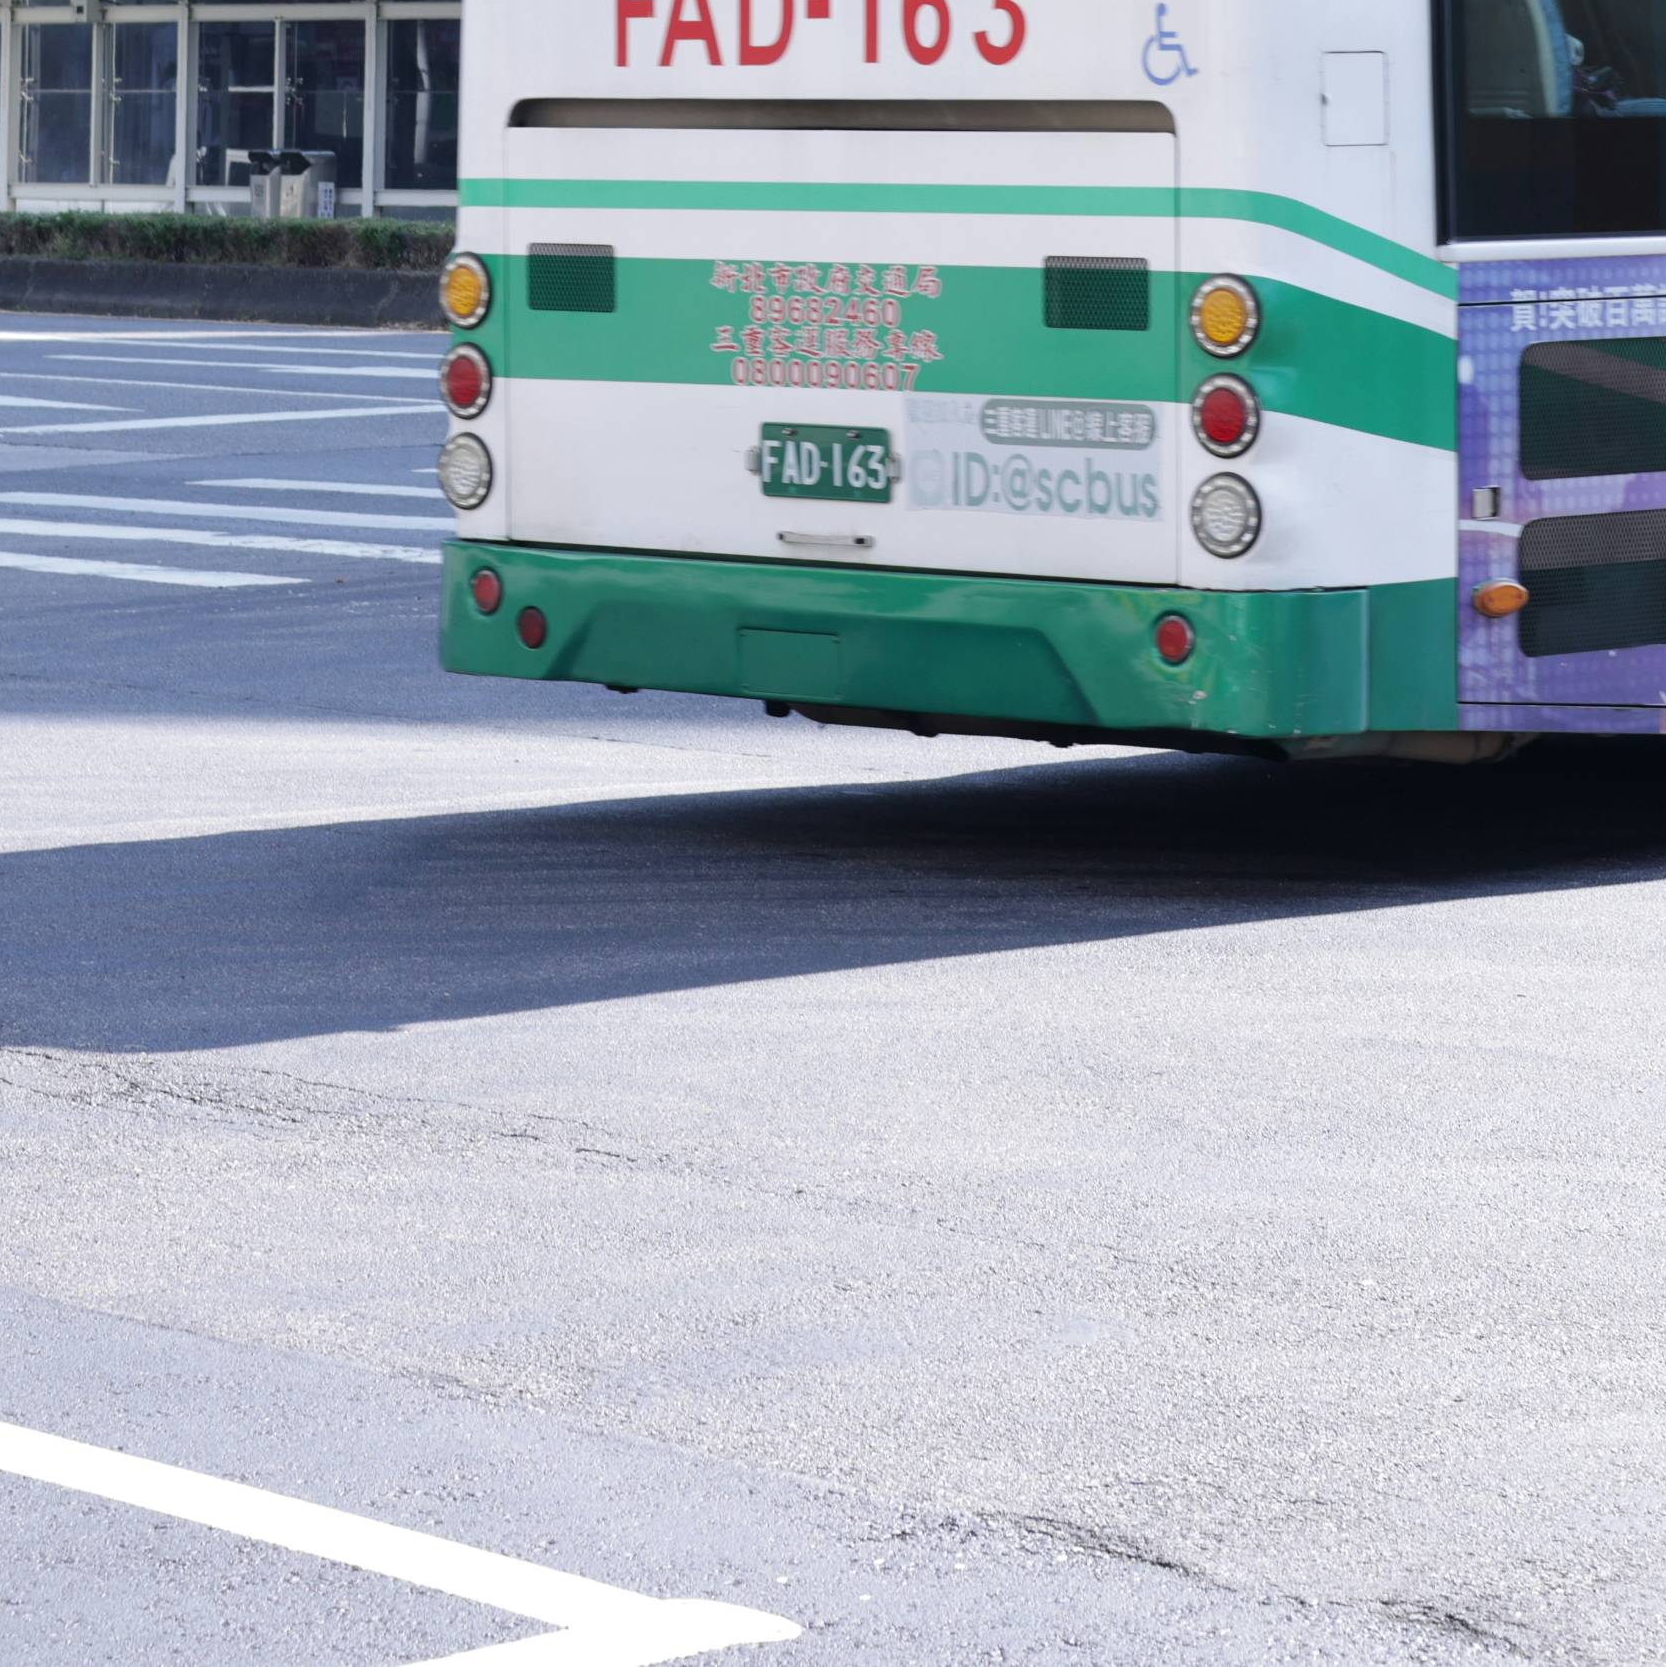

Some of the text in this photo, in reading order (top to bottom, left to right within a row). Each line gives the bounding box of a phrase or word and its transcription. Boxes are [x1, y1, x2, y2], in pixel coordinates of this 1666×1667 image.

[710, 261, 942, 299] 新北市政府交通局
[749, 295, 901, 327] 89682460
[710, 325, 944, 362] 三重客運服務專線
[732, 356, 920, 391] 0800090607
[762, 440, 887, 489] FAD-163
[951, 451, 1159, 517] ID:@scbus
